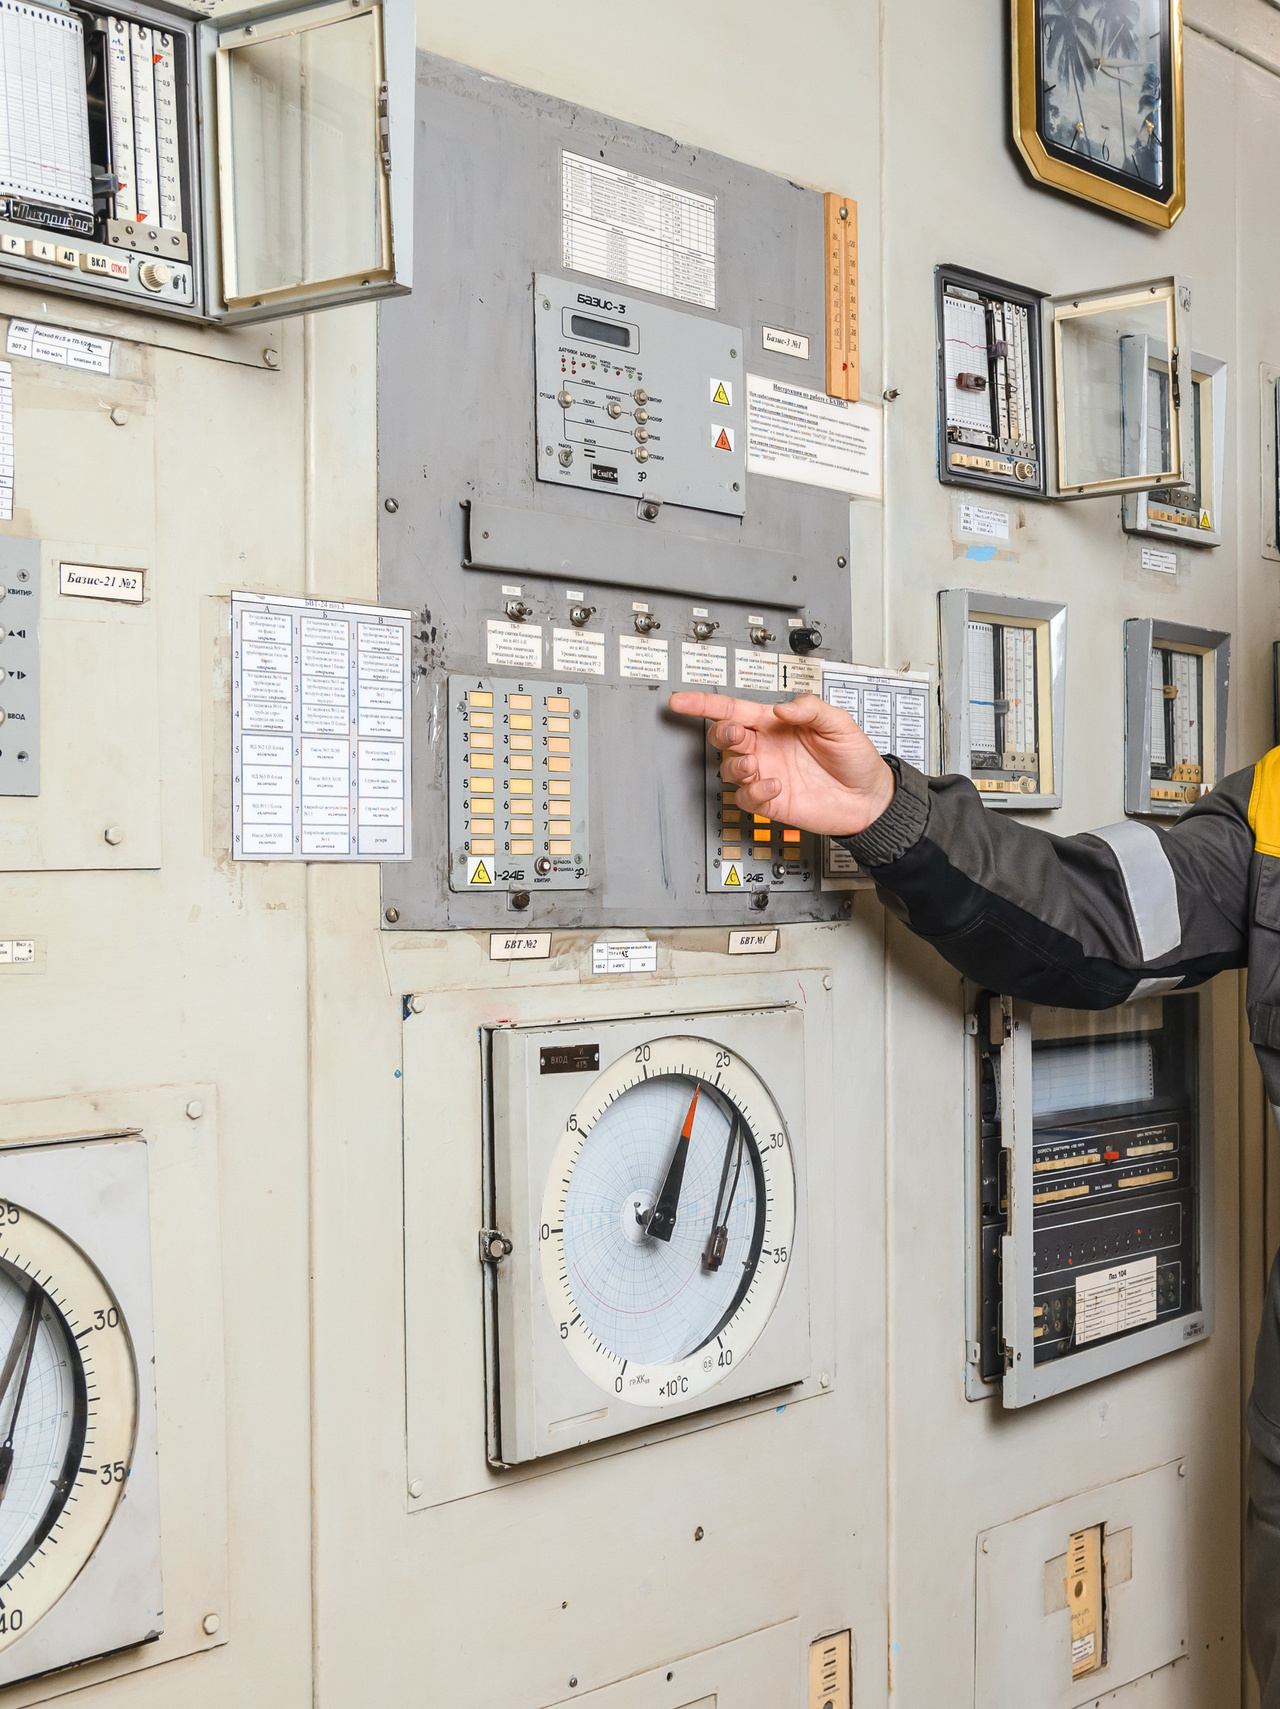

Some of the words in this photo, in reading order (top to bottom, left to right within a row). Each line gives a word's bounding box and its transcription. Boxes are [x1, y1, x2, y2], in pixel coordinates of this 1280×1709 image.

[1102, 139, 1109, 162] 6
[11, 240, 16, 249] Р
[42, 246, 47, 255] А
[64, 251, 75, 262] АП
[91, 257, 106, 268] ВКЛ
[110, 262, 127, 275] ОТКЛ
[14, 325, 29, 333] FIRC
[35, 330, 54, 339] Расход
[766, 333, 790, 346] Базис-3
[12, 342, 27, 350] 307-2
[558, 346, 578, 356] ДАТЧИКИ
[539, 392, 555, 400] ОБЩАЯ
[718, 390, 724, 400] С
[721, 436, 726, 446] Б
[67, 571, 116, 588] Базис-21
[118, 576, 138, 590] №2
[7, 588, 34, 597] КВИТИР.
[235, 680, 239, 688] 3
[464, 692, 468, 700] 1
[504, 694, 508, 703] 1
[543, 697, 547, 706] 1
[7, 713, 26, 721] ВВОД
[463, 712, 468, 721] 2
[503, 715, 509, 724] 2
[542, 717, 548, 726] 2
[463, 733, 469, 742] 3
[503, 735, 509, 744] 3
[542, 737, 548, 746] 3
[463, 754, 469, 763] 4
[503, 756, 509, 765] 4
[542, 757, 548, 766] 4
[463, 779, 469, 788] 5
[503, 780, 509, 790] 5
[542, 782, 548, 790] 5
[463, 800, 469, 810] 6
[503, 800, 509, 810] 6
[542, 802, 548, 810] 6
[464, 821, 469, 830] 7
[504, 821, 509, 830] 7
[543, 822, 548, 830] 7
[718, 830, 721, 838] 7
[464, 841, 470, 851] 8
[504, 841, 510, 850] 8
[544, 842, 549, 850] 8
[718, 848, 721, 856] 8
[748, 848, 752, 856] 8
[477, 869, 485, 880] С
[730, 872, 736, 882] С
[504, 940, 522, 949] БВТ
[523, 939, 538, 949] №2
[740, 936, 755, 945] БВТ
[634, 1045, 651, 1063] 20
[550, 1055, 568, 1064] ВХОД
[715, 1050, 731, 1069] 25
[770, 1132, 784, 1148] 30
[773, 1247, 788, 1264] 35
[1118, 1269, 1127, 1278] 104
[94, 1306, 119, 1331] 30
[560, 1323, 569, 1340] 5
[718, 1349, 733, 1368] 40
[615, 1376, 623, 1393] 0
[100, 1461, 126, 1486] 35
